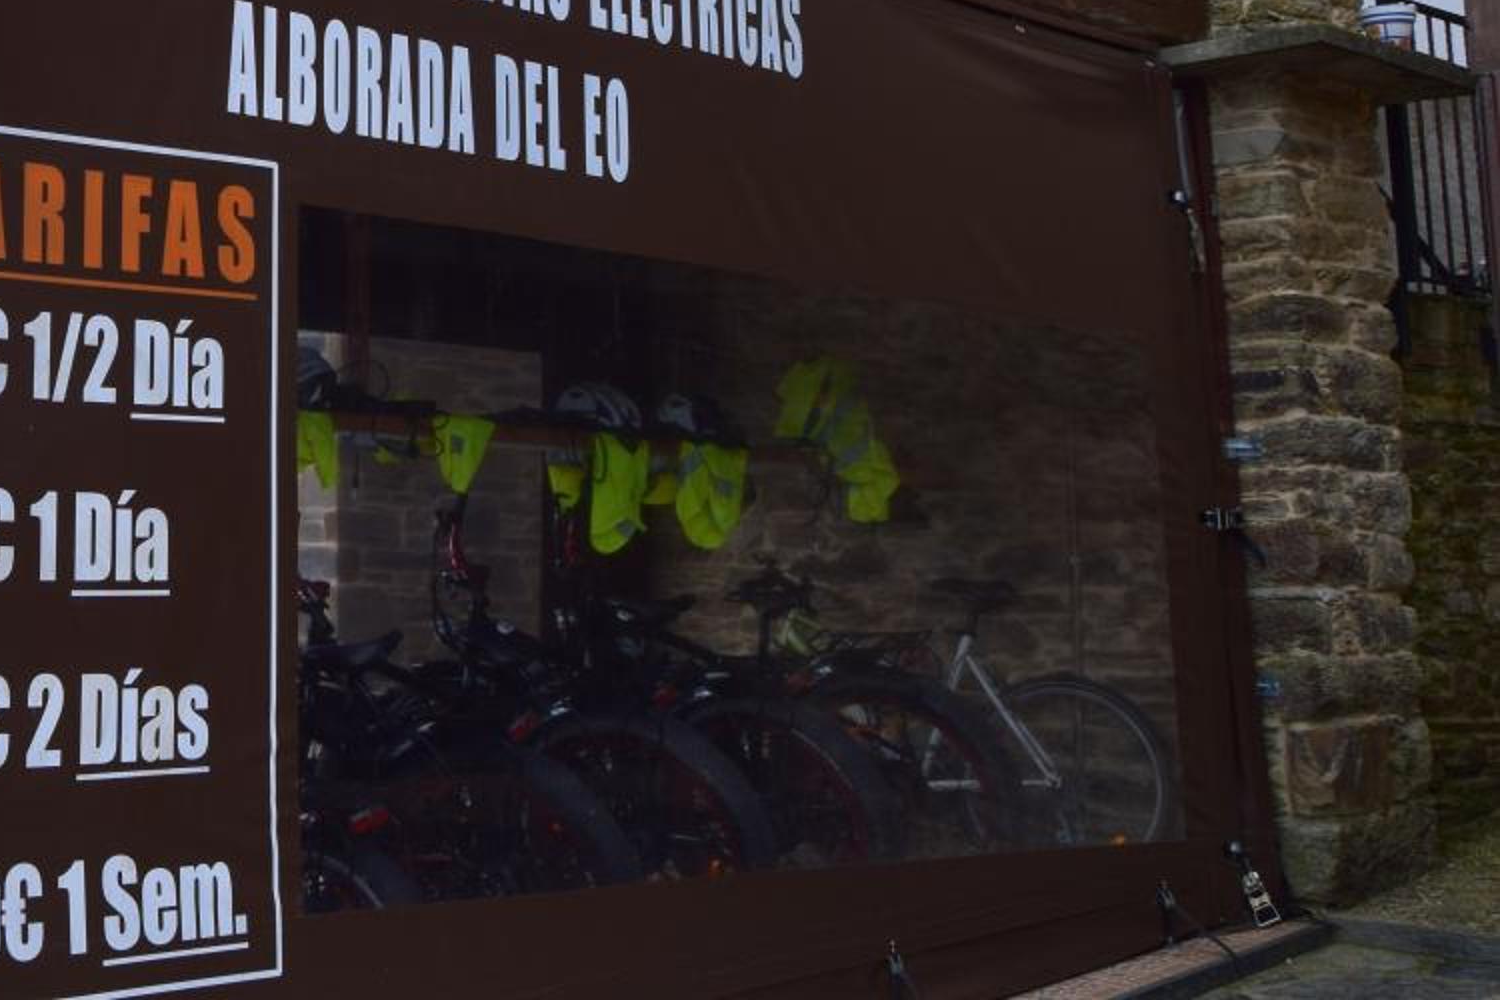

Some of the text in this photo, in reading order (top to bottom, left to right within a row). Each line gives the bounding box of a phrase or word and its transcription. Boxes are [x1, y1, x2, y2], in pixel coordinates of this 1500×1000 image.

[227, 0, 629, 183] ALBORADA DEL EO
[23, 311, 119, 404] 1/2
[133, 319, 224, 409] Día
[29, 490, 58, 582] 1
[74, 489, 169, 583] Día
[25, 673, 65, 769] 2
[79, 667, 209, 765] Días
[57, 859, 87, 955] 1
[101, 854, 248, 951] Sem.
